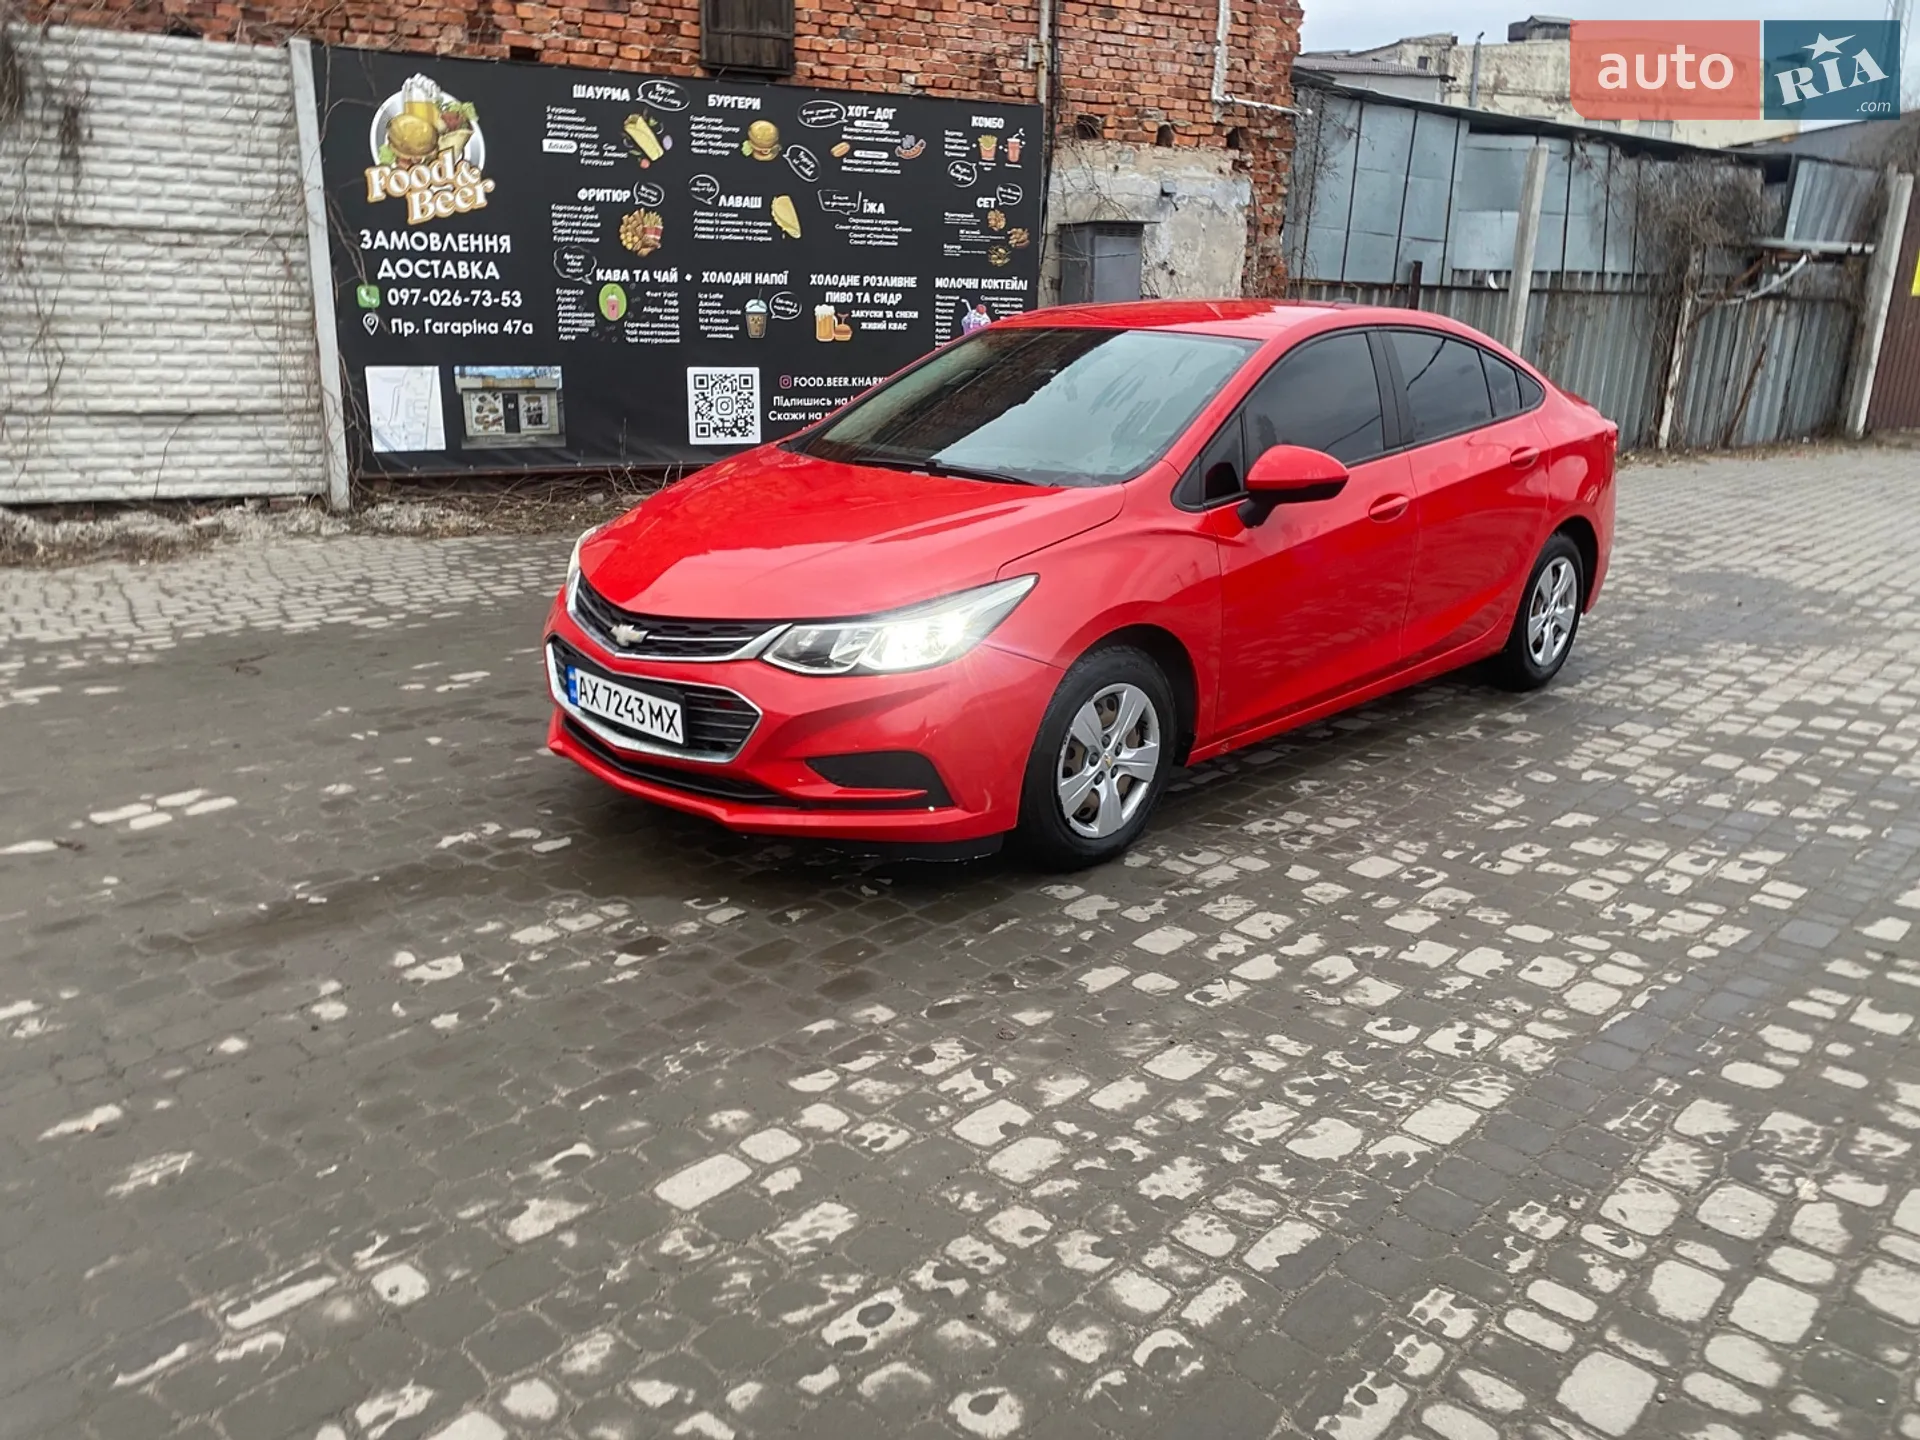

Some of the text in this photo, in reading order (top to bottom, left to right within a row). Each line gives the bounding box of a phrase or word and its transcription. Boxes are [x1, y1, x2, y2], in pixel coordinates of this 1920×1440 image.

[573, 84, 631, 102] ШАУРМА
[708, 95, 761, 110] БУРГЕРИ
[847, 106, 896, 120] ХОТ-ДОГ
[972, 116, 1004, 129] КОМБО
[408, 179, 495, 225] Beer
[578, 188, 631, 202] ФРИТЮР
[718, 195, 762, 208] ЛАВАШ
[863, 199, 885, 214] ЇЖА
[977, 197, 996, 208] СЕТ
[360, 230, 511, 253] ЗАМОВЛЕННЯ
[377, 258, 500, 280] ДОСТАВКА
[596, 267, 678, 284] КАВА ТА ЧАЙ
[702, 270, 789, 286] ХОЛОДНІ НАПОЇ
[810, 274, 917, 287] ХОЛОДНЕ РОЗЛИВНЕ
[935, 277, 1027, 290] МОЛОЧНІ КОКТЕЙЛІ
[388, 288, 522, 308] 097-026-73-53
[826, 292, 902, 305] ПИВО ТА СИДР
[851, 310, 883, 318] ЗАКУСКИ
[391, 318, 533, 338] Пр. Гагаріна 47а
[861, 320, 886, 330] ЖИВИЙ
[774, 396, 832, 407] Підпишись
[835, 399, 848, 408] на
[769, 411, 805, 421] Скажи
[808, 412, 824, 422] на
